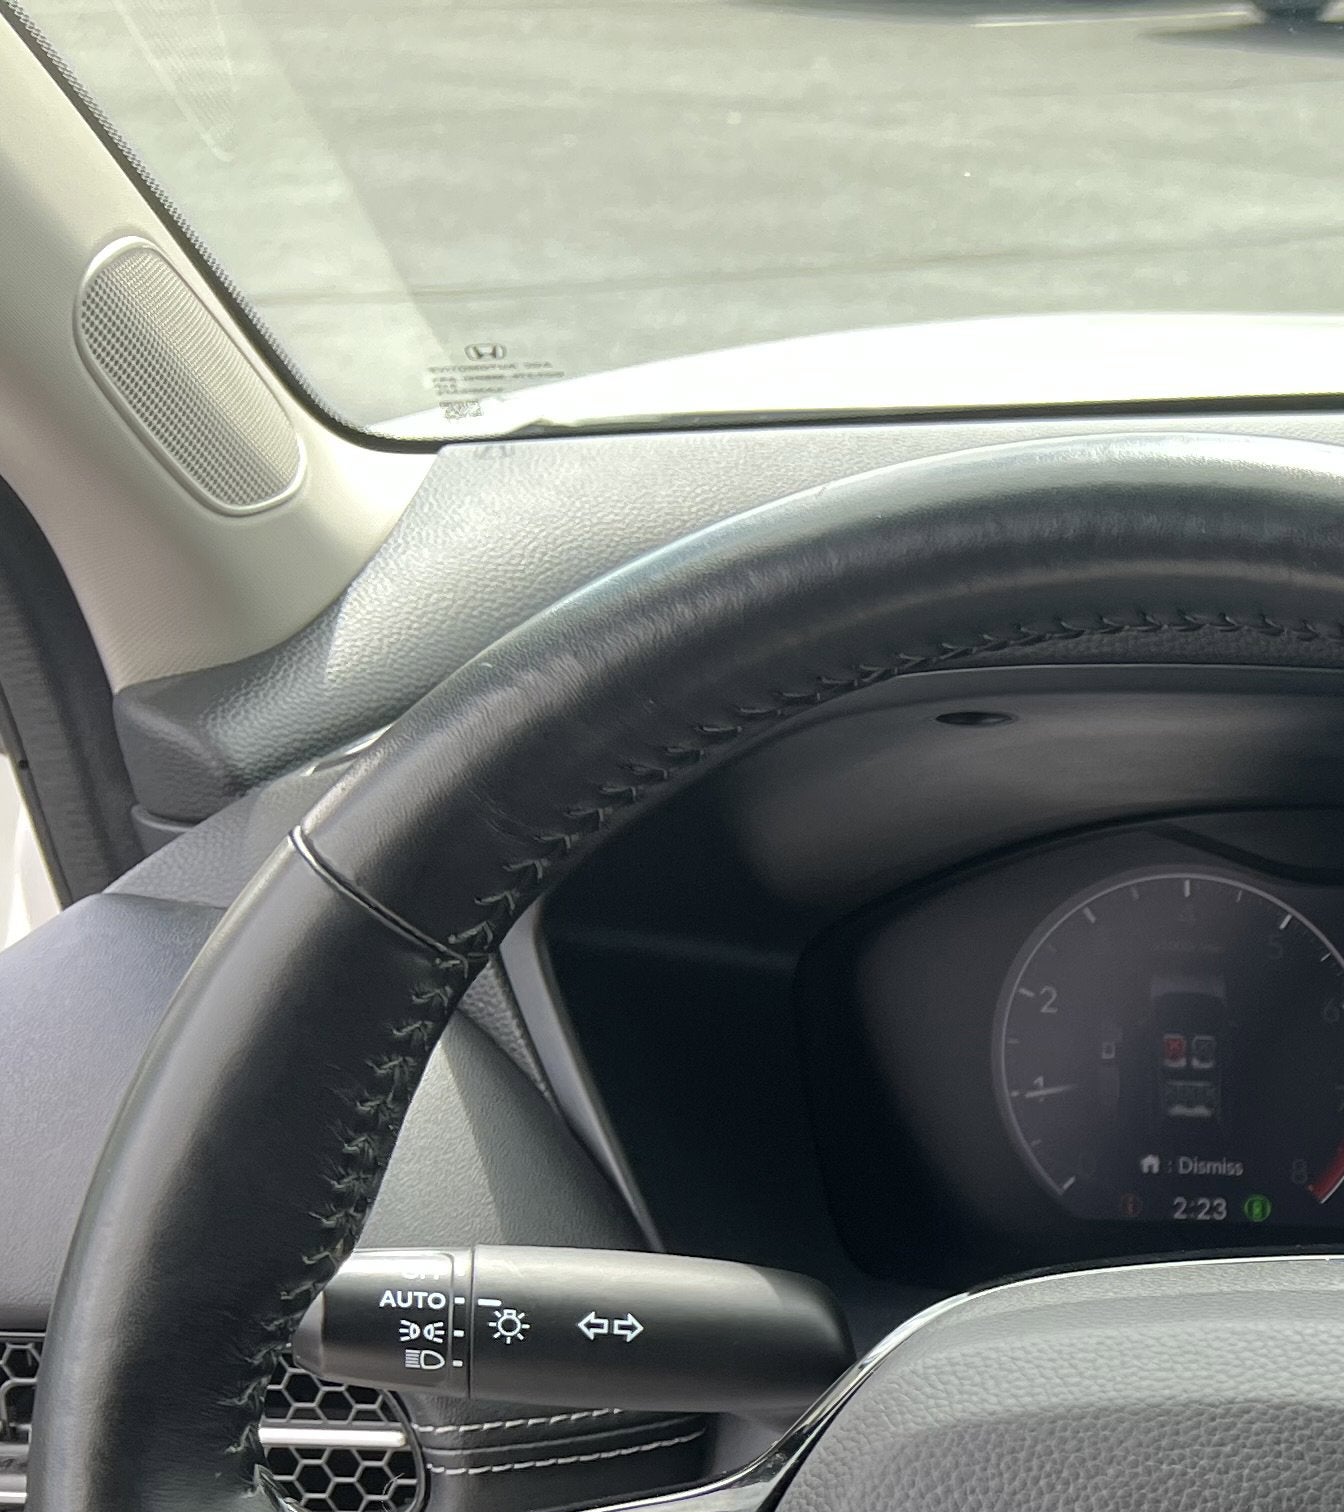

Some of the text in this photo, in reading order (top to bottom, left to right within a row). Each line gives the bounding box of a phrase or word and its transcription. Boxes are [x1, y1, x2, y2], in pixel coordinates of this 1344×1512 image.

[1039, 988, 1058, 1014] 2
[1179, 1157, 1244, 1177] Dismiss
[1173, 1198, 1227, 1221] 2:23
[380, 1290, 446, 1309] AUTO
